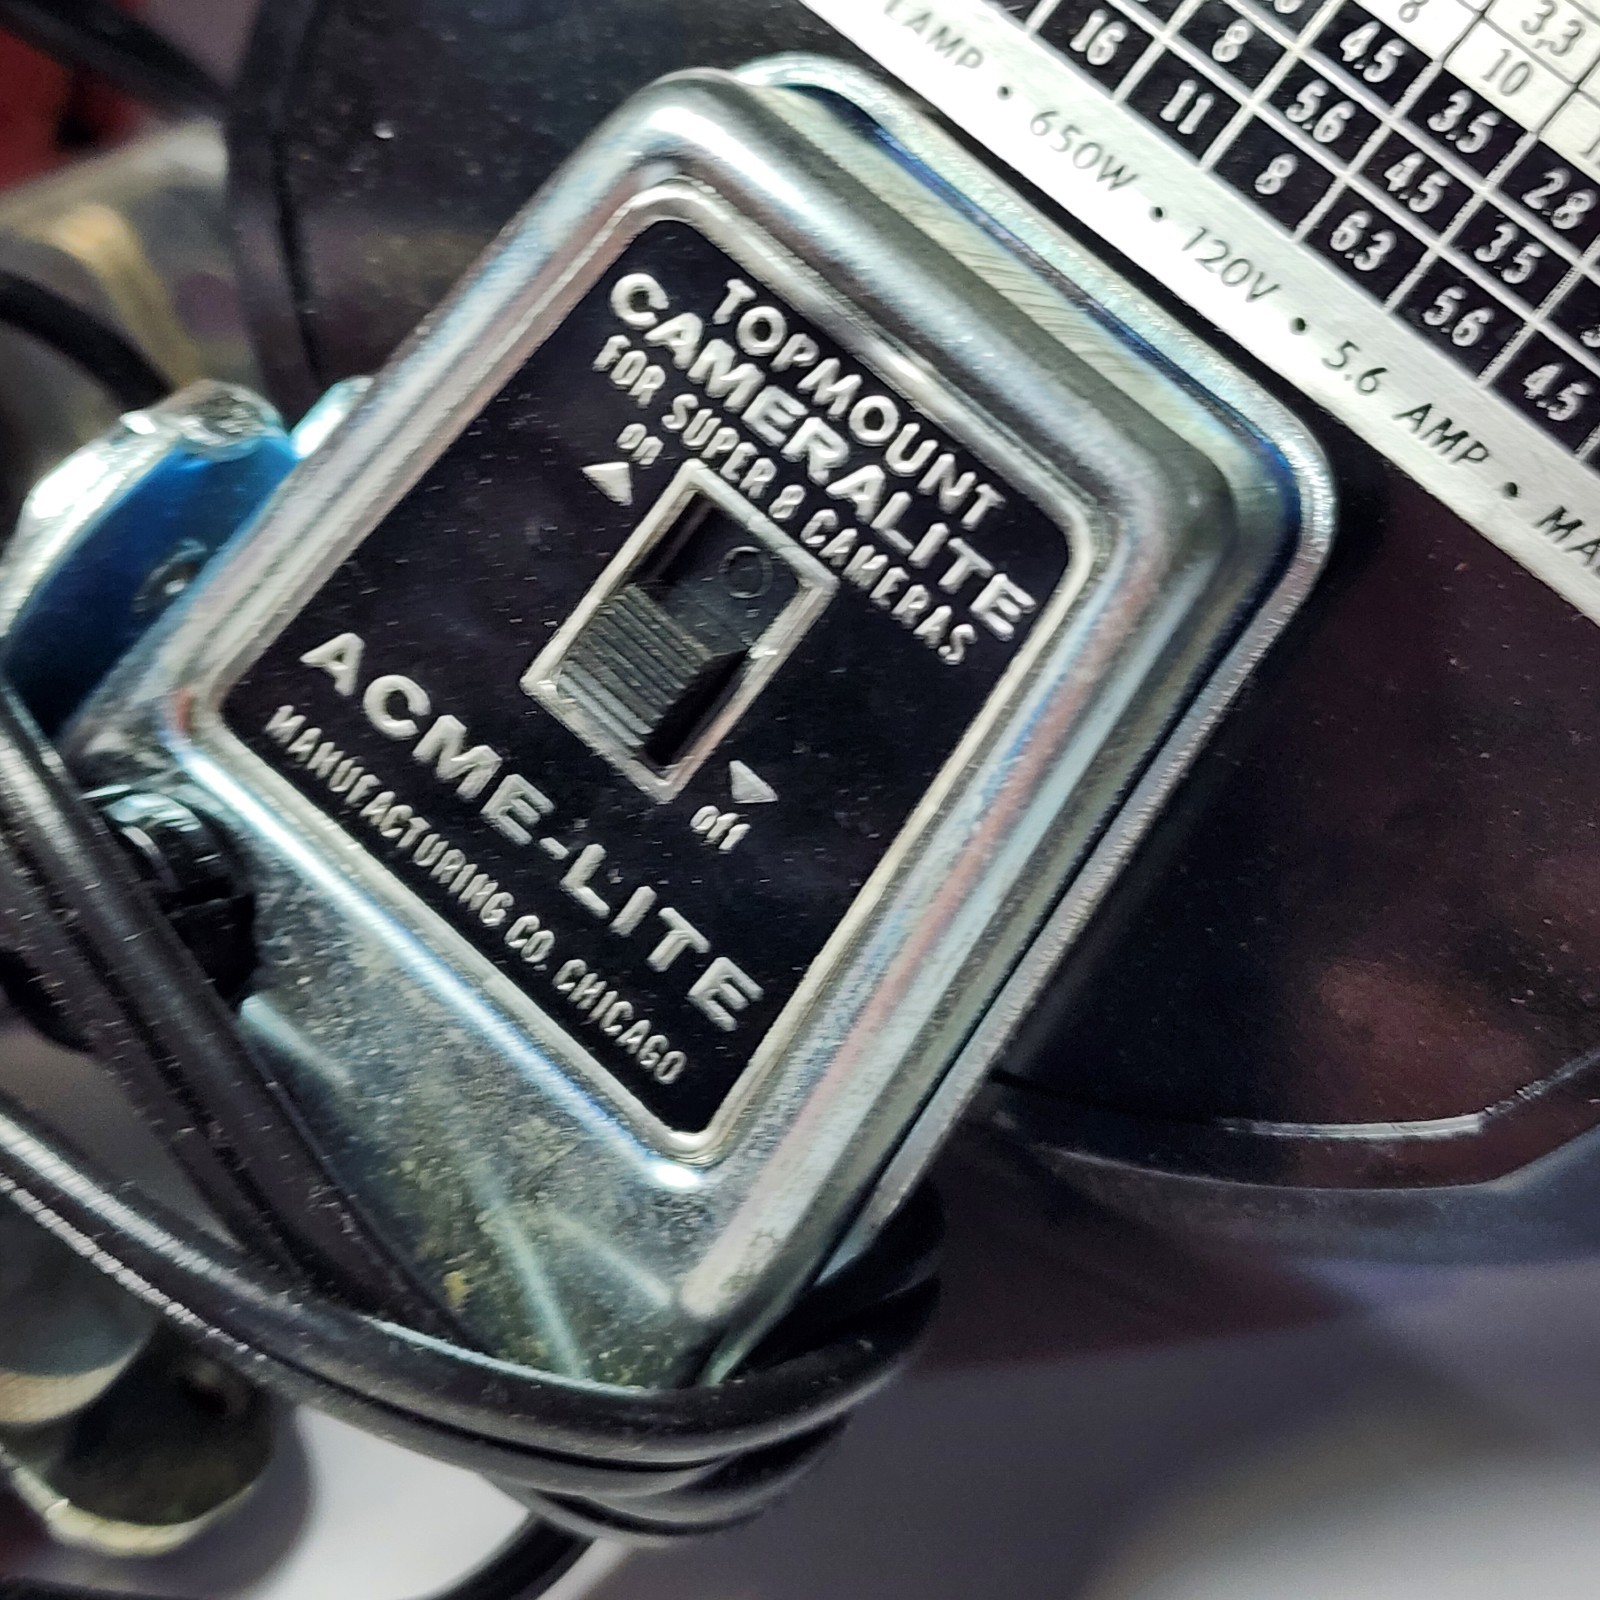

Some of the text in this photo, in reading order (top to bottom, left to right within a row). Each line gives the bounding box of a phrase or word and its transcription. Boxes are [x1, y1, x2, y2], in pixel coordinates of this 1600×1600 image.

[884, 0, 984, 69] LAMP
[1030, 110, 1138, 191] 650W
[1182, 227, 1280, 302] 120V
[1321, 340, 1388, 394] 5.6
[1393, 403, 1489, 465] AMP
[1069, 9, 1595, 421] 16 11 8 6.3 5.6 4.5
[1212, 19, 1545, 284] 8 5.6 4.5 3.5
[1340, 21, 1597, 229] 4.5 3.5 2.8
[1481, 49, 1534, 96] 10
[592, 334, 977, 665] FOR SUPER 8 CAMERAS
[610, 273, 1036, 642] CAMERALITE
[713, 279, 1006, 532] TOPMOUNT
[264, 704, 688, 1085] MANUFACTURING CO. CHICAGO
[300, 632, 764, 1031] ACME-LITE
